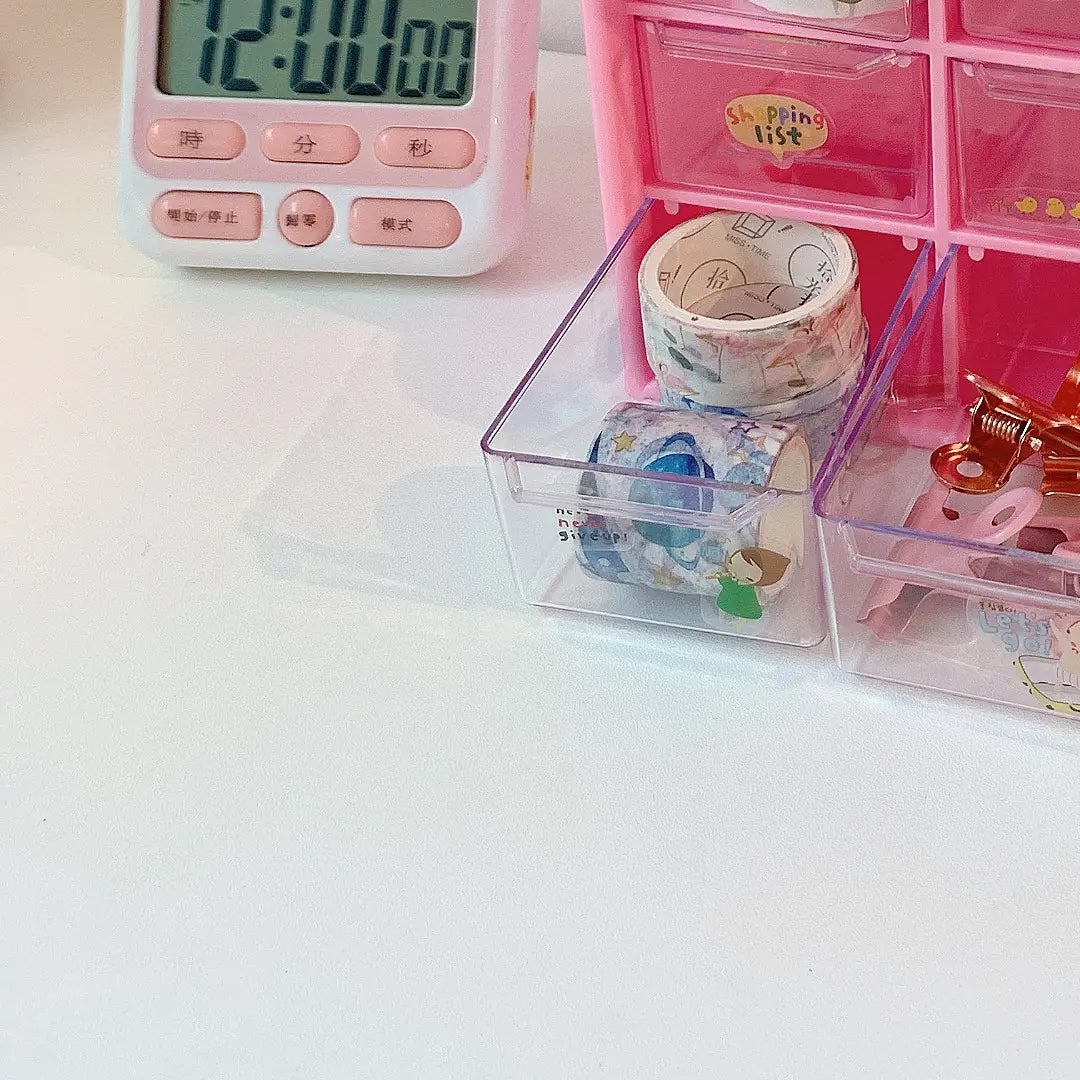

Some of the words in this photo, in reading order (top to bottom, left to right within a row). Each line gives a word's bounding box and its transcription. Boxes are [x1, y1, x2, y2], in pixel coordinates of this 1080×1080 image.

[179, 129, 204, 149] 時
[294, 134, 317, 154] 分
[755, 124, 802, 146] list
[408, 138, 433, 158] 秒
[381, 216, 413, 232] 模式
